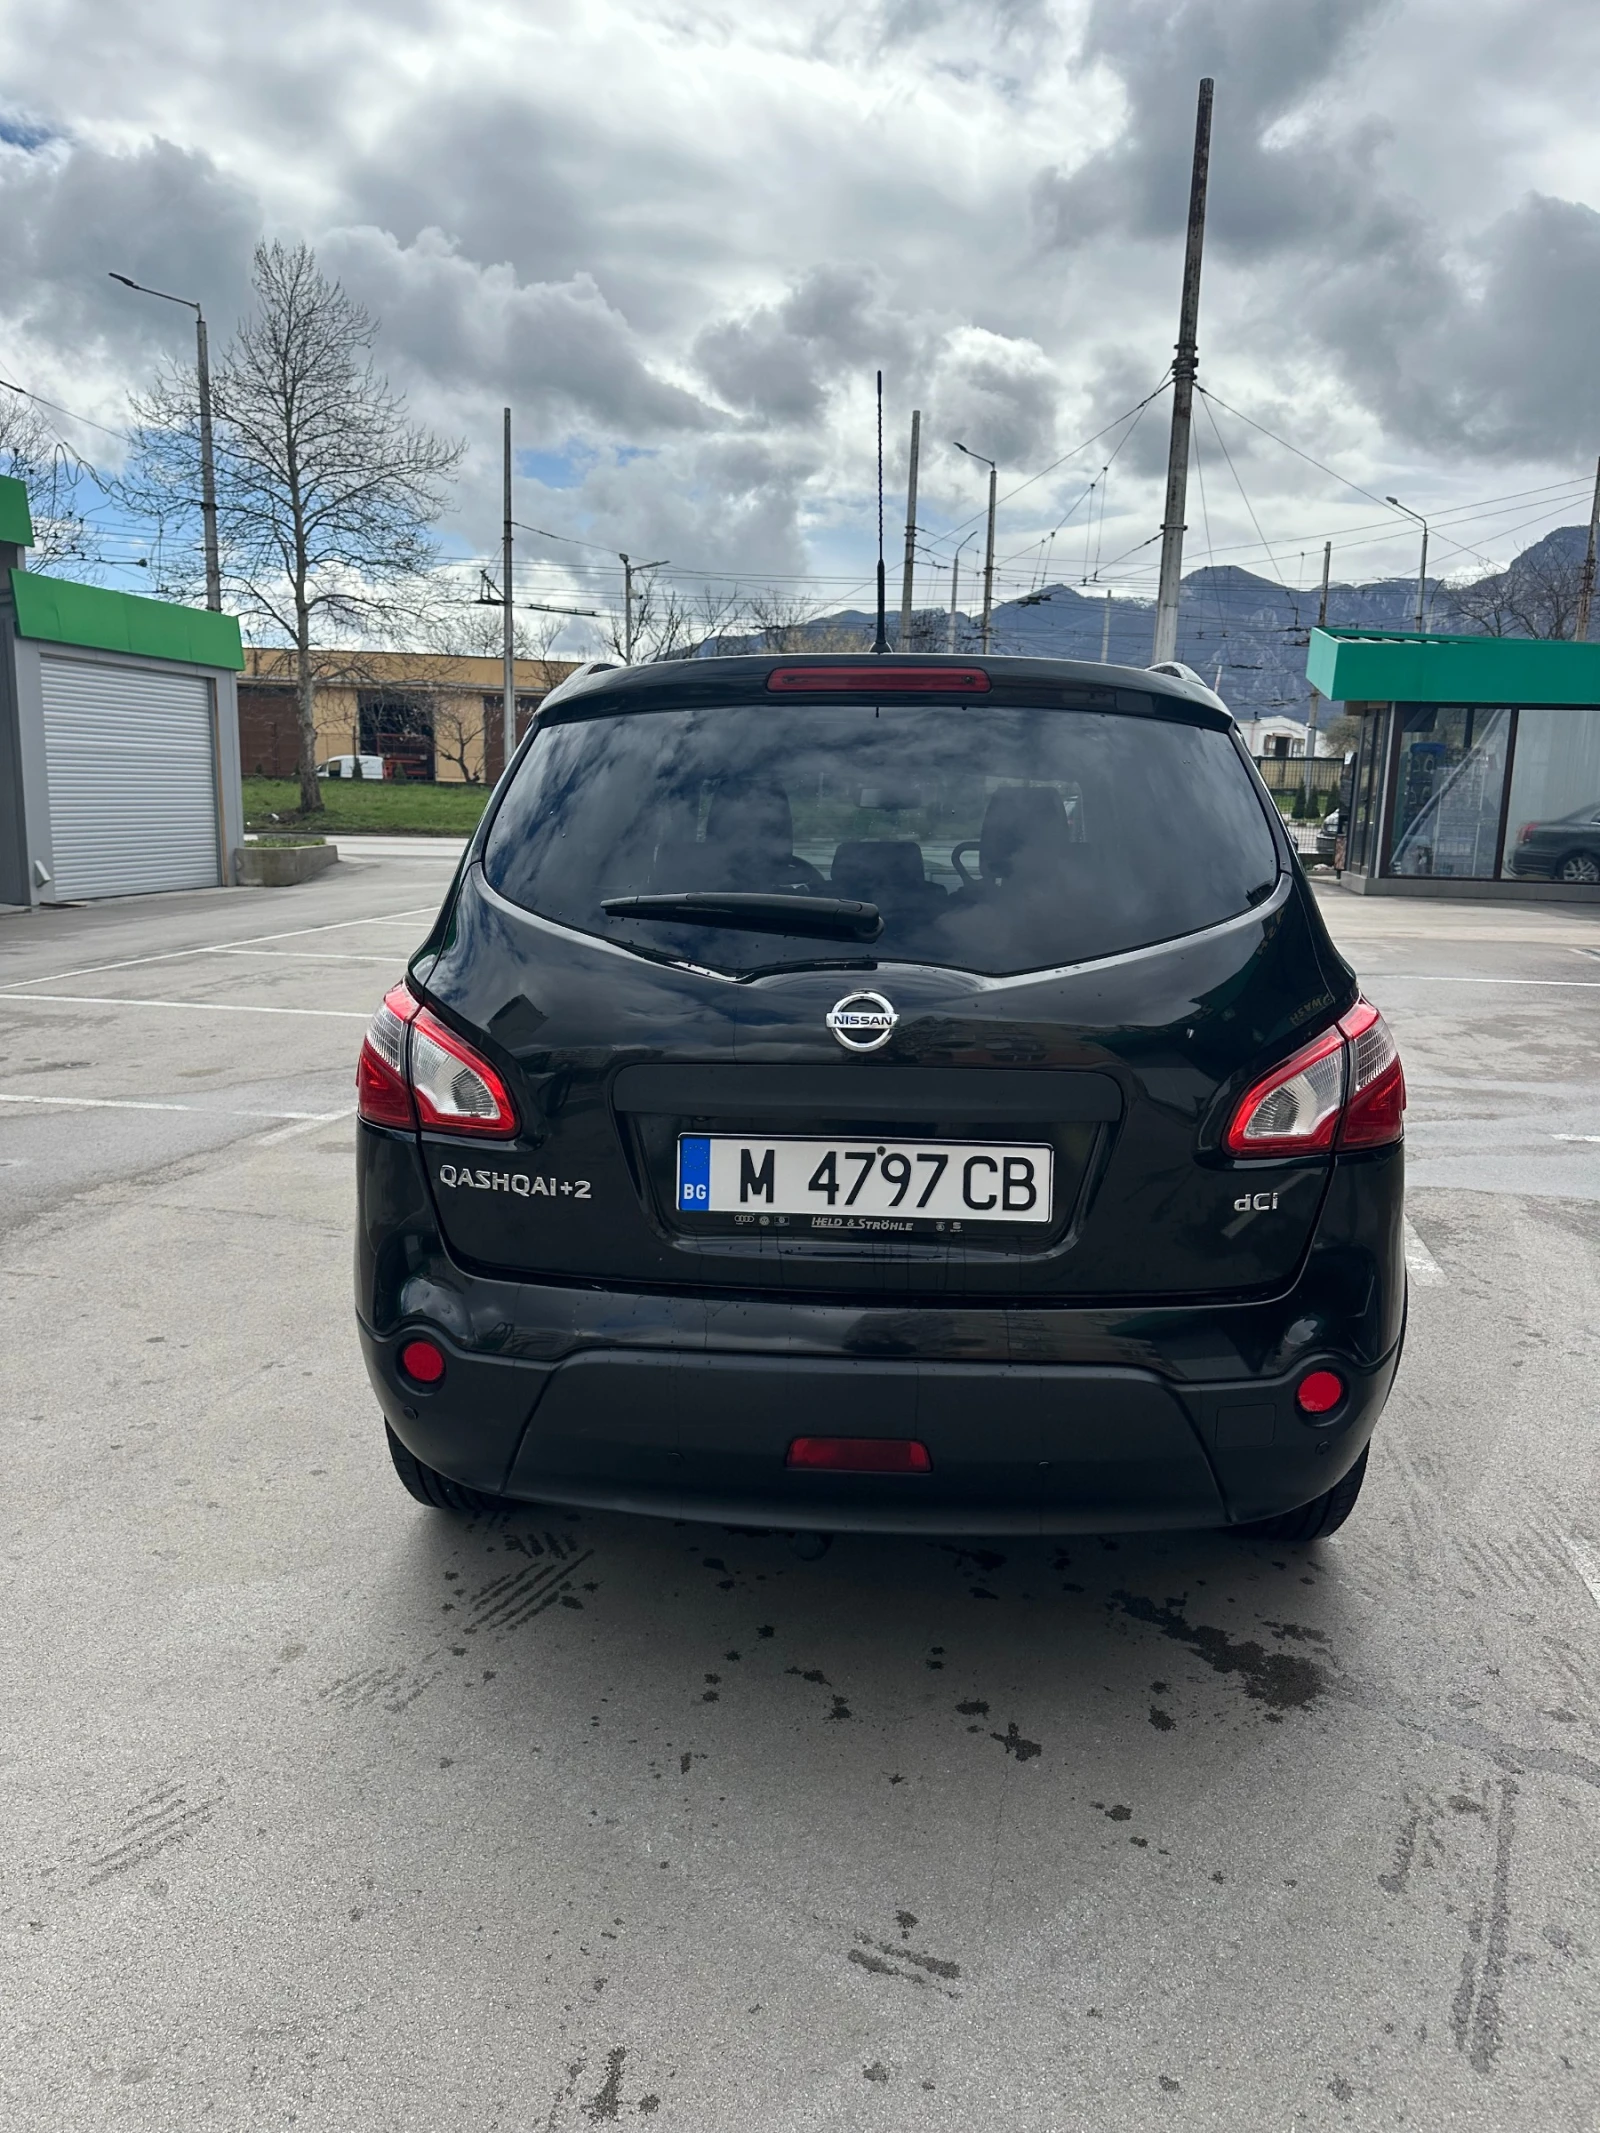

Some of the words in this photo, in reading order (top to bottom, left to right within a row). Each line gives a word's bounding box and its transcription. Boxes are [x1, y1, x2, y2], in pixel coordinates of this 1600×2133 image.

[834, 1015, 892, 1026] NISSAN
[740, 1148, 775, 1204] M
[807, 1151, 949, 1209] 4797
[962, 1156, 1037, 1211] CB
[683, 1183, 707, 1200] BG
[1233, 1192, 1279, 1212] dCi
[811, 1216, 843, 1228] HELD
[846, 1218, 855, 1227] &
